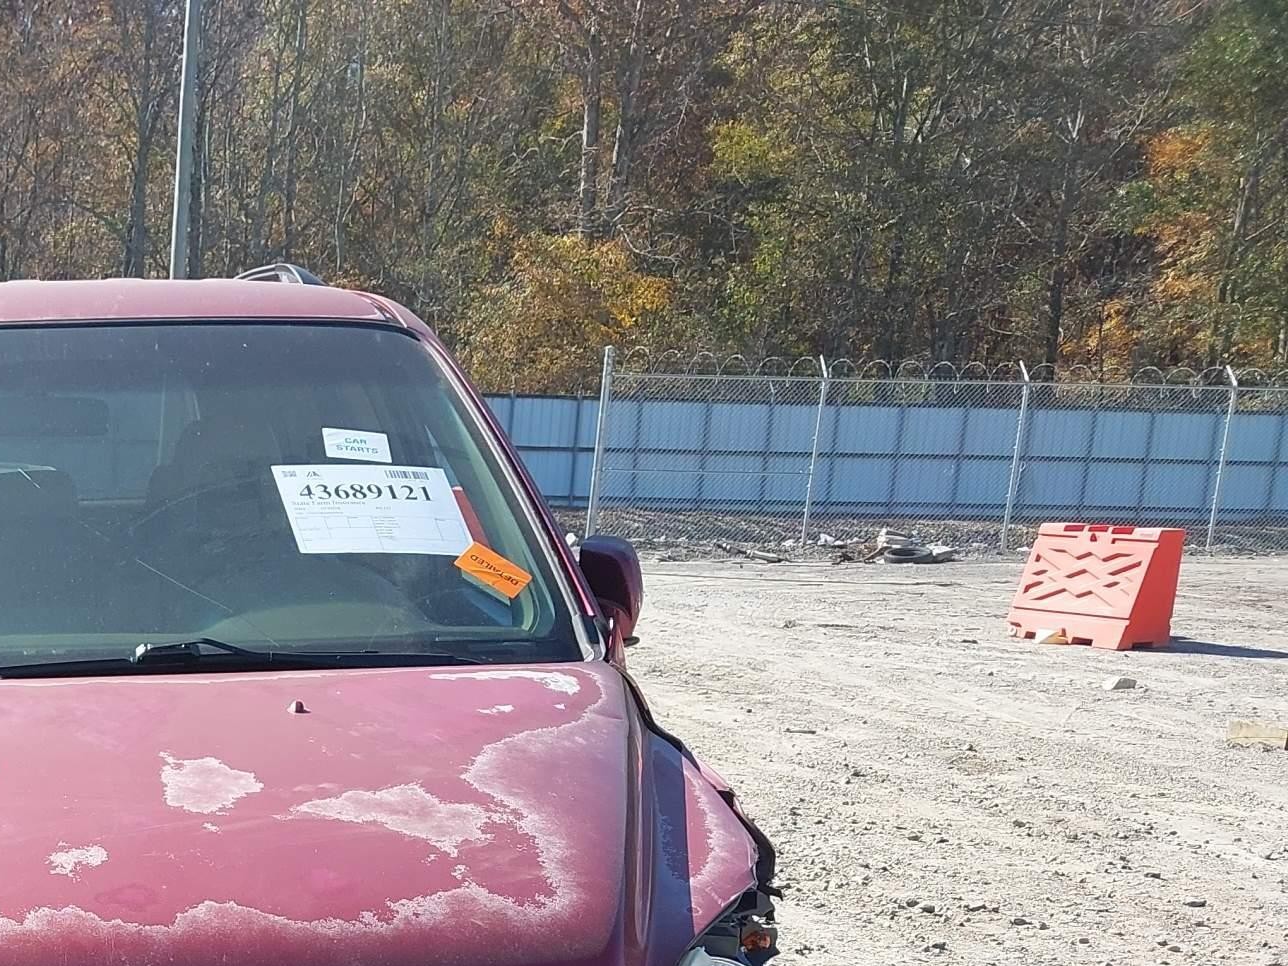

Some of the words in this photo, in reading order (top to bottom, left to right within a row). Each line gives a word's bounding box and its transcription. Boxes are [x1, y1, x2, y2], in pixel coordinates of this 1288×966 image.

[344, 437, 367, 445] CAR
[335, 444, 379, 454] STARTS
[299, 483, 432, 502] 43689121
[470, 554, 520, 586] DETAILED
